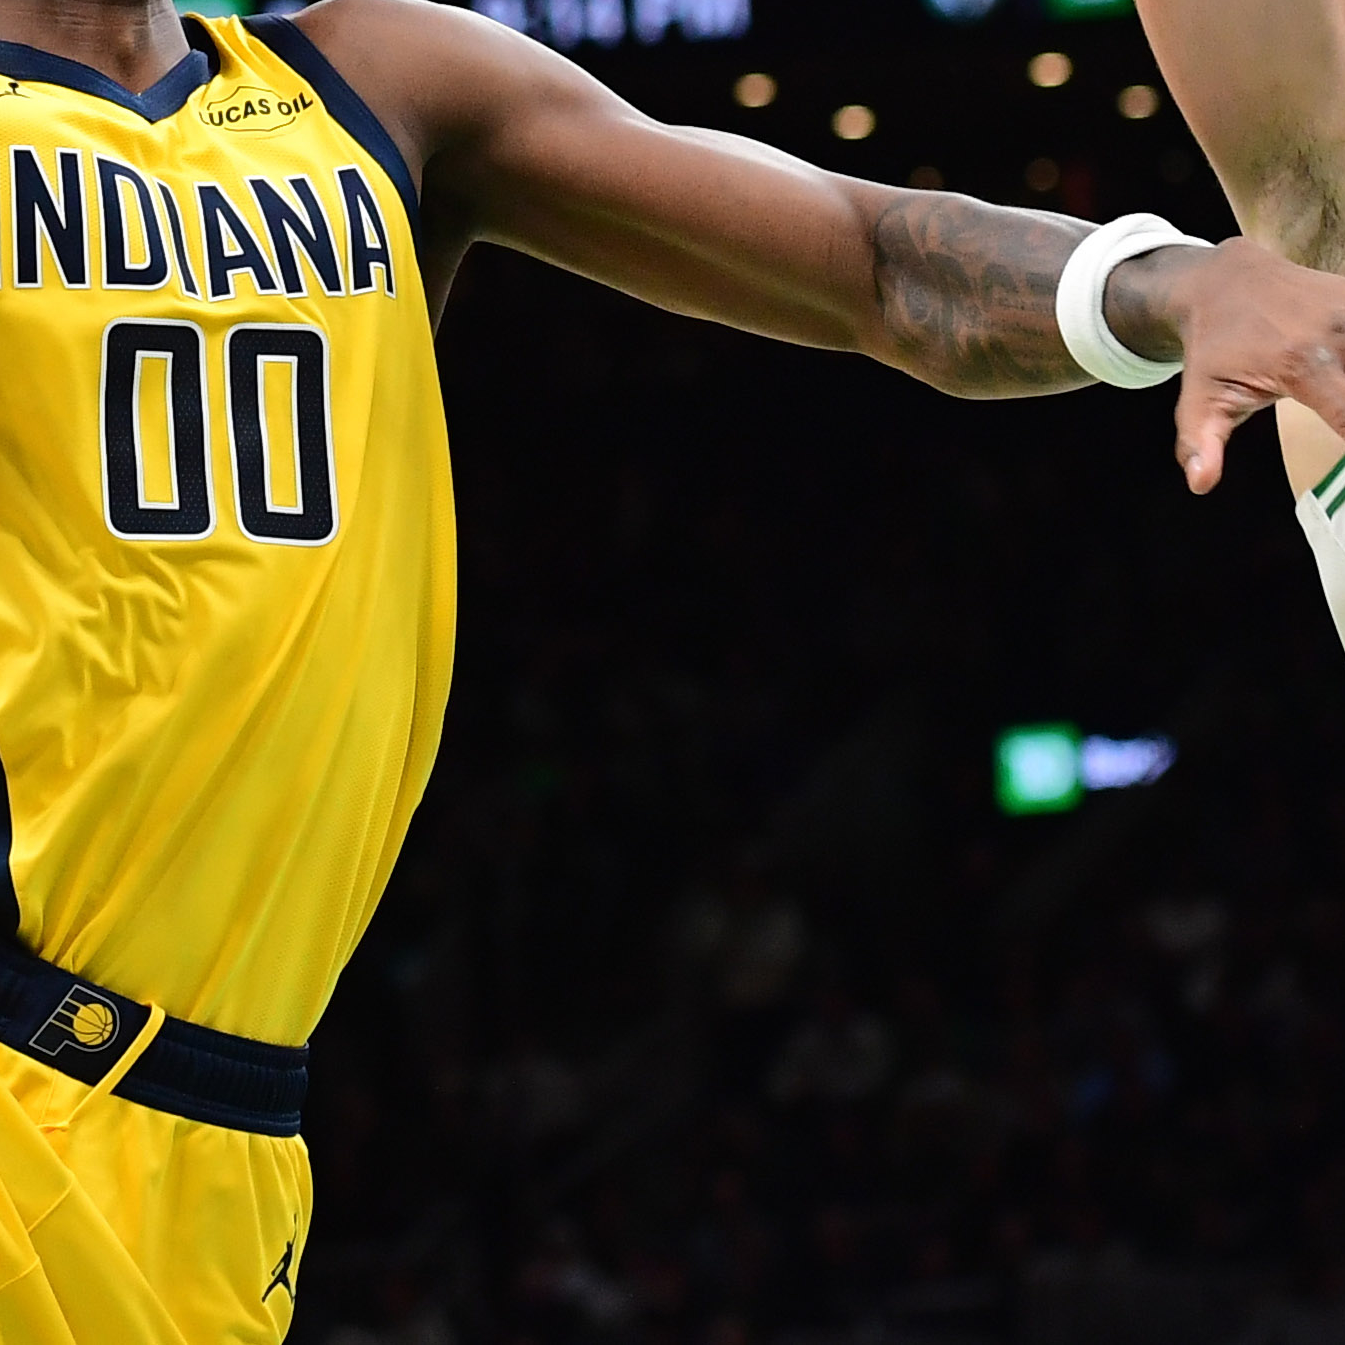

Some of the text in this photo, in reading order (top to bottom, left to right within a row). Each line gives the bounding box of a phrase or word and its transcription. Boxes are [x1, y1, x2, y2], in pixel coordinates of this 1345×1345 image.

[207, 91, 314, 127] UCAS OIL
[100, 317, 340, 546] 00
